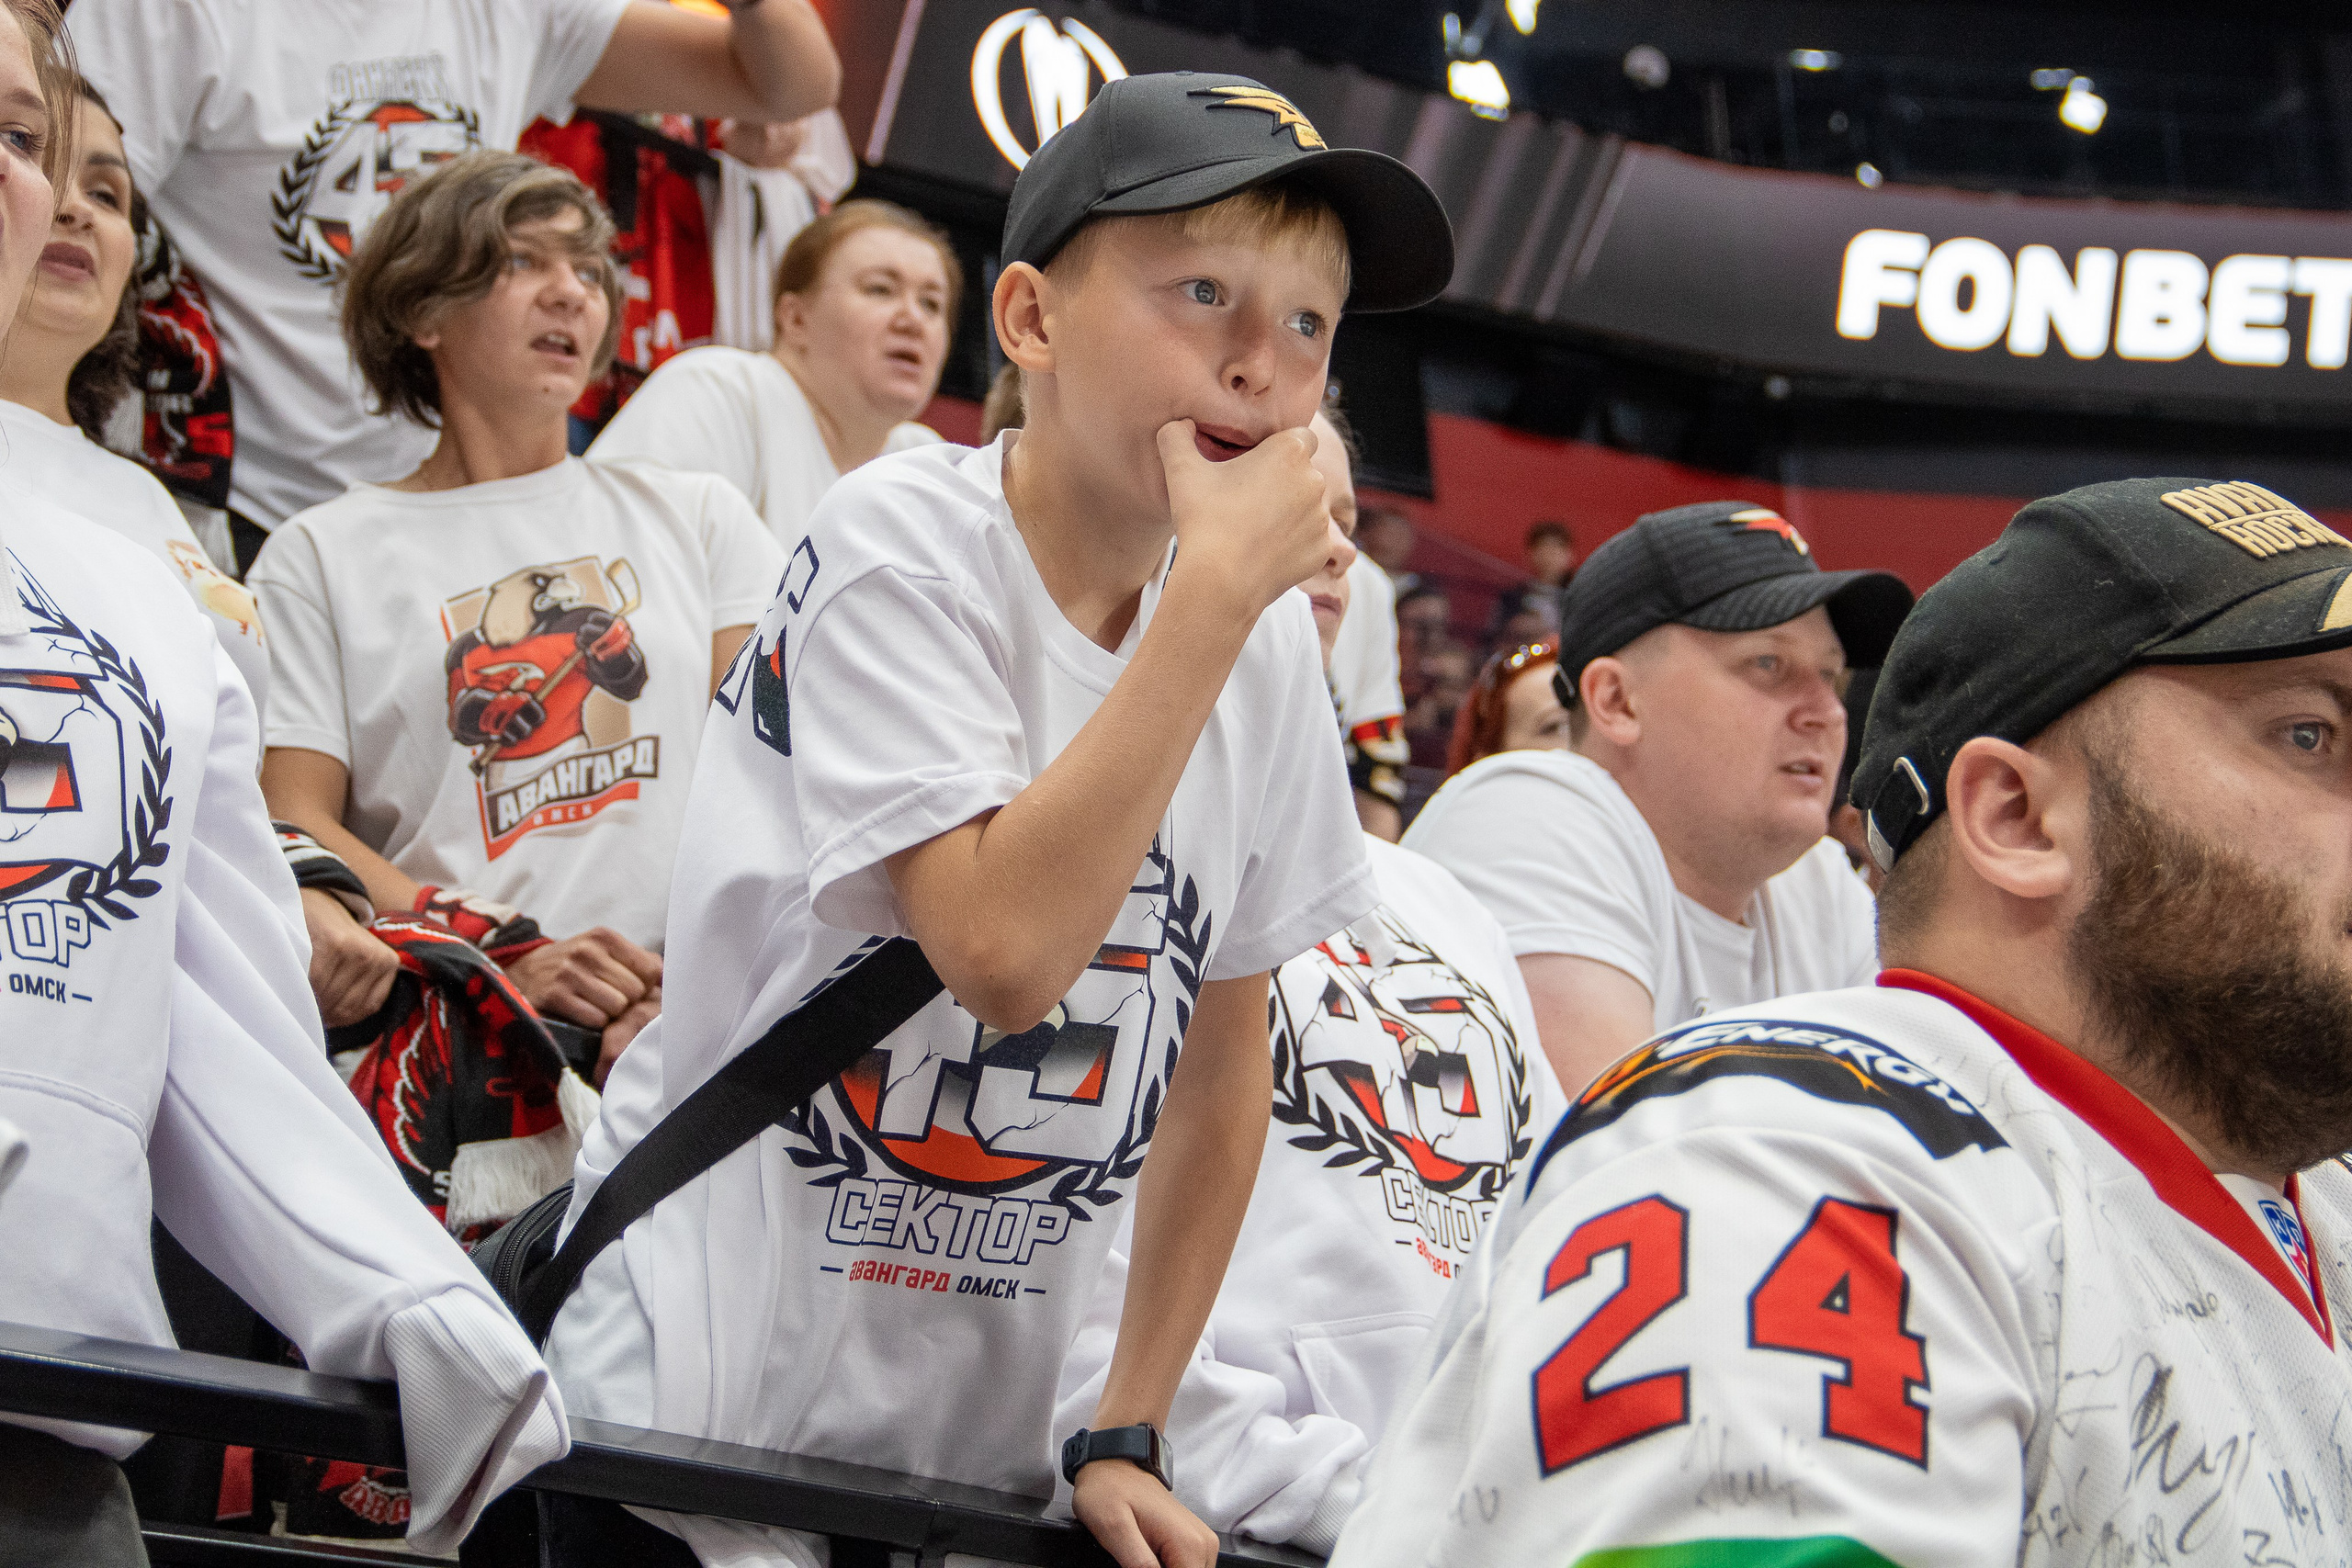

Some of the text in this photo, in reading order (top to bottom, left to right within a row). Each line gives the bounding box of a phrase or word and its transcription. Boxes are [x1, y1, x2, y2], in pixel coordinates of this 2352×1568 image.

[1838, 228, 2352, 369] FONBET
[497, 738, 654, 830] АВАНГАРД
[9, 973, 66, 1003] ОМСК
[1657, 1021, 1976, 1116] ENERGY
[826, 1178, 1072, 1265] СЕКТОР
[956, 1275, 1020, 1300] ОМСК
[1531, 1192, 1930, 1475] 24
